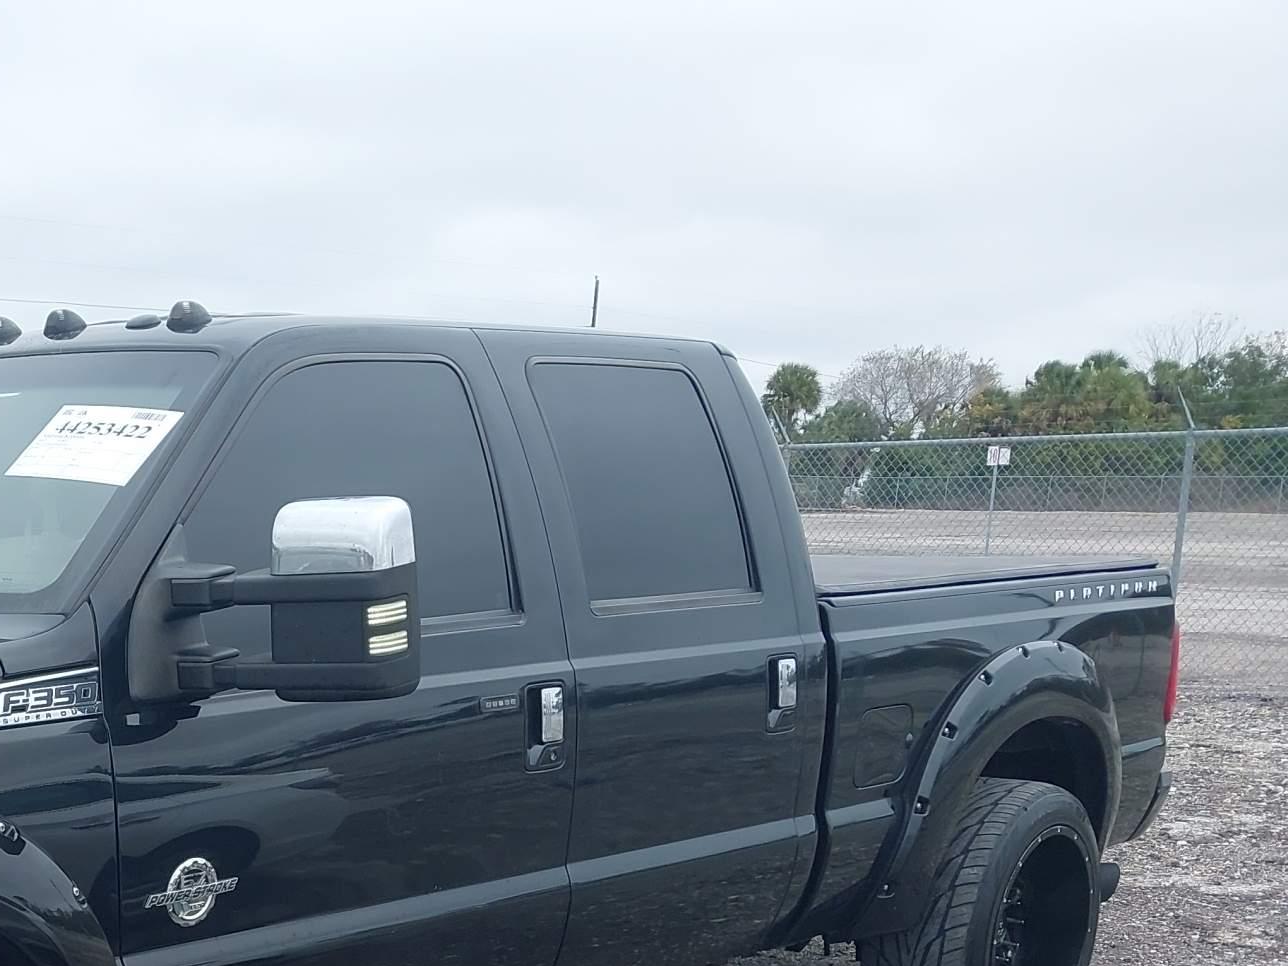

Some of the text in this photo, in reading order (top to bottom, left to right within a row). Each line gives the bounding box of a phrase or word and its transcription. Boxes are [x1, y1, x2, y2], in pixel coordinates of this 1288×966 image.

[55, 420, 153, 439] 44253422
[2, 704, 101, 725] SUPER DUTY
[145, 888, 191, 909] POWER
[191, 876, 239, 898] STROKE
